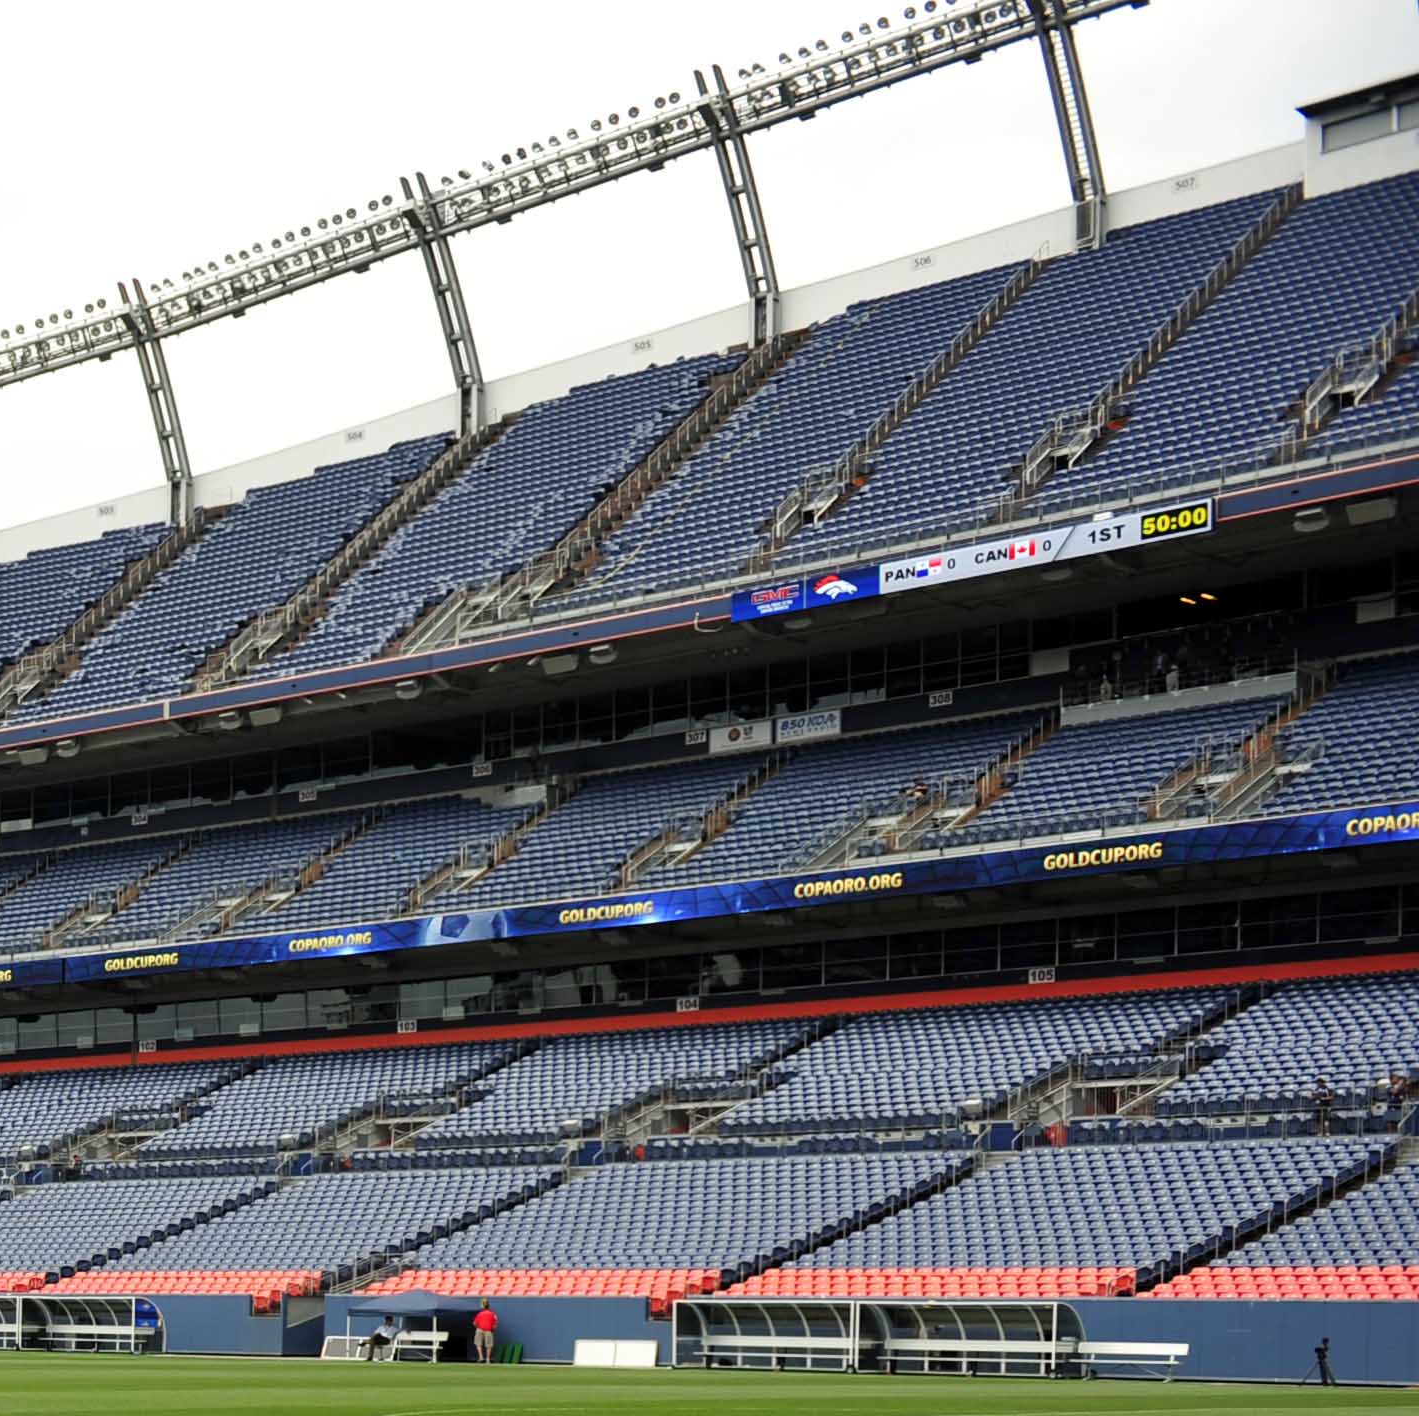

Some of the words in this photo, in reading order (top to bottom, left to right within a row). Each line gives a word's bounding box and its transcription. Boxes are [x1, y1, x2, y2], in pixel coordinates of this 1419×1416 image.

[884, 566, 916, 583] PAN
[947, 558, 956, 570] 0
[974, 547, 1009, 565] CAN
[1042, 540, 1053, 552] 0
[1087, 524, 1126, 545] 1ST
[1142, 506, 1207, 536] 50:00
[1043, 842, 1163, 871] GOLDCUP.ORG
[794, 872, 903, 899] COPAORO.ORG
[559, 900, 655, 924] GOLDCUP.ORG
[104, 952, 179, 972] GOLDCUP.ORG
[1029, 967, 1055, 983] 105
[677, 998, 700, 1011] 104
[397, 1020, 417, 1033] 103
[139, 1041, 157, 1052] 102
